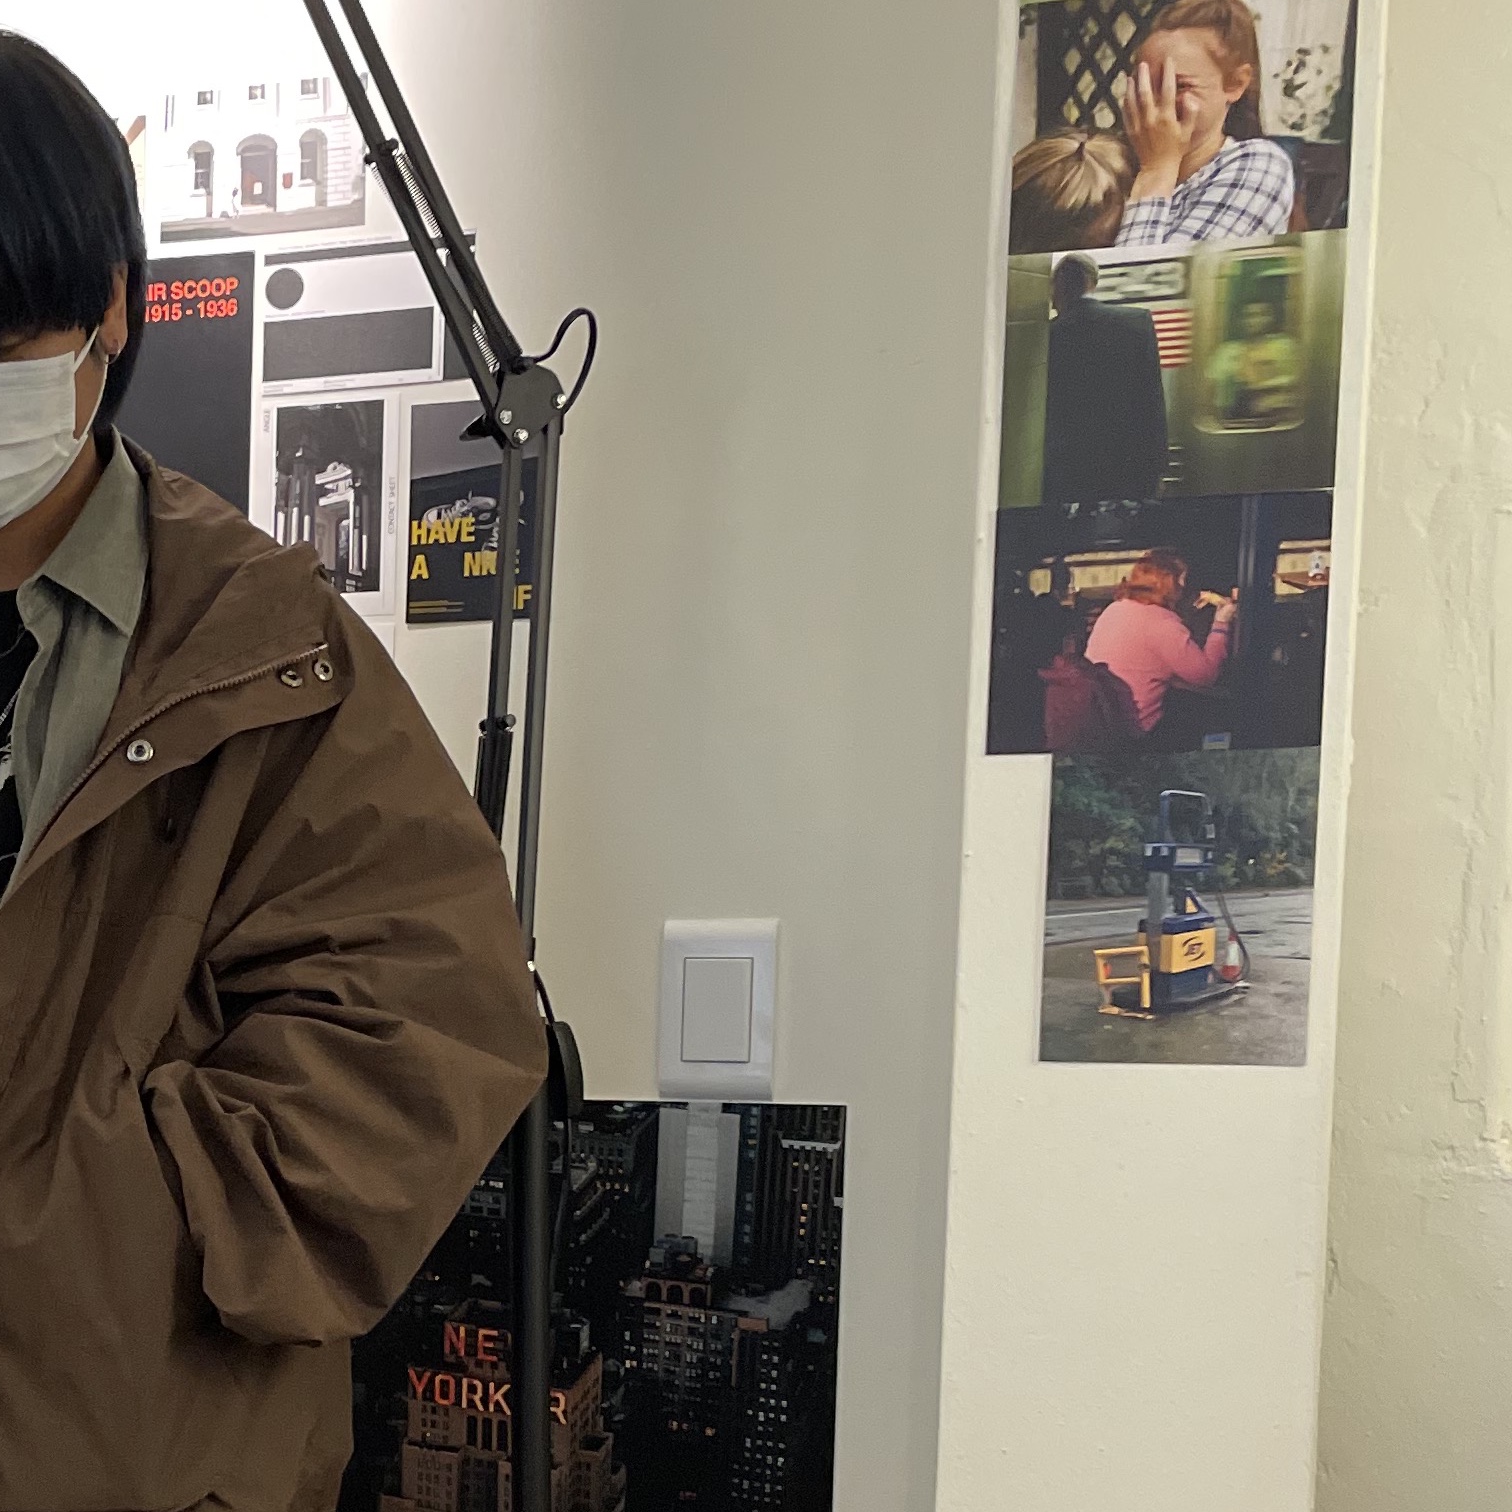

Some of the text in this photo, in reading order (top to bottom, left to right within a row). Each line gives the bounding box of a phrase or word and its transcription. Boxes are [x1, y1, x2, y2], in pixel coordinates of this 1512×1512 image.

[170, 276, 240, 301] SCOOP
[145, 301, 183, 323] 1915
[196, 297, 238, 319] 1936
[410, 516, 476, 546] HAVE
[409, 553, 429, 580] A
[444, 1321, 512, 1362] NE
[408, 1366, 567, 1426] YORKR
